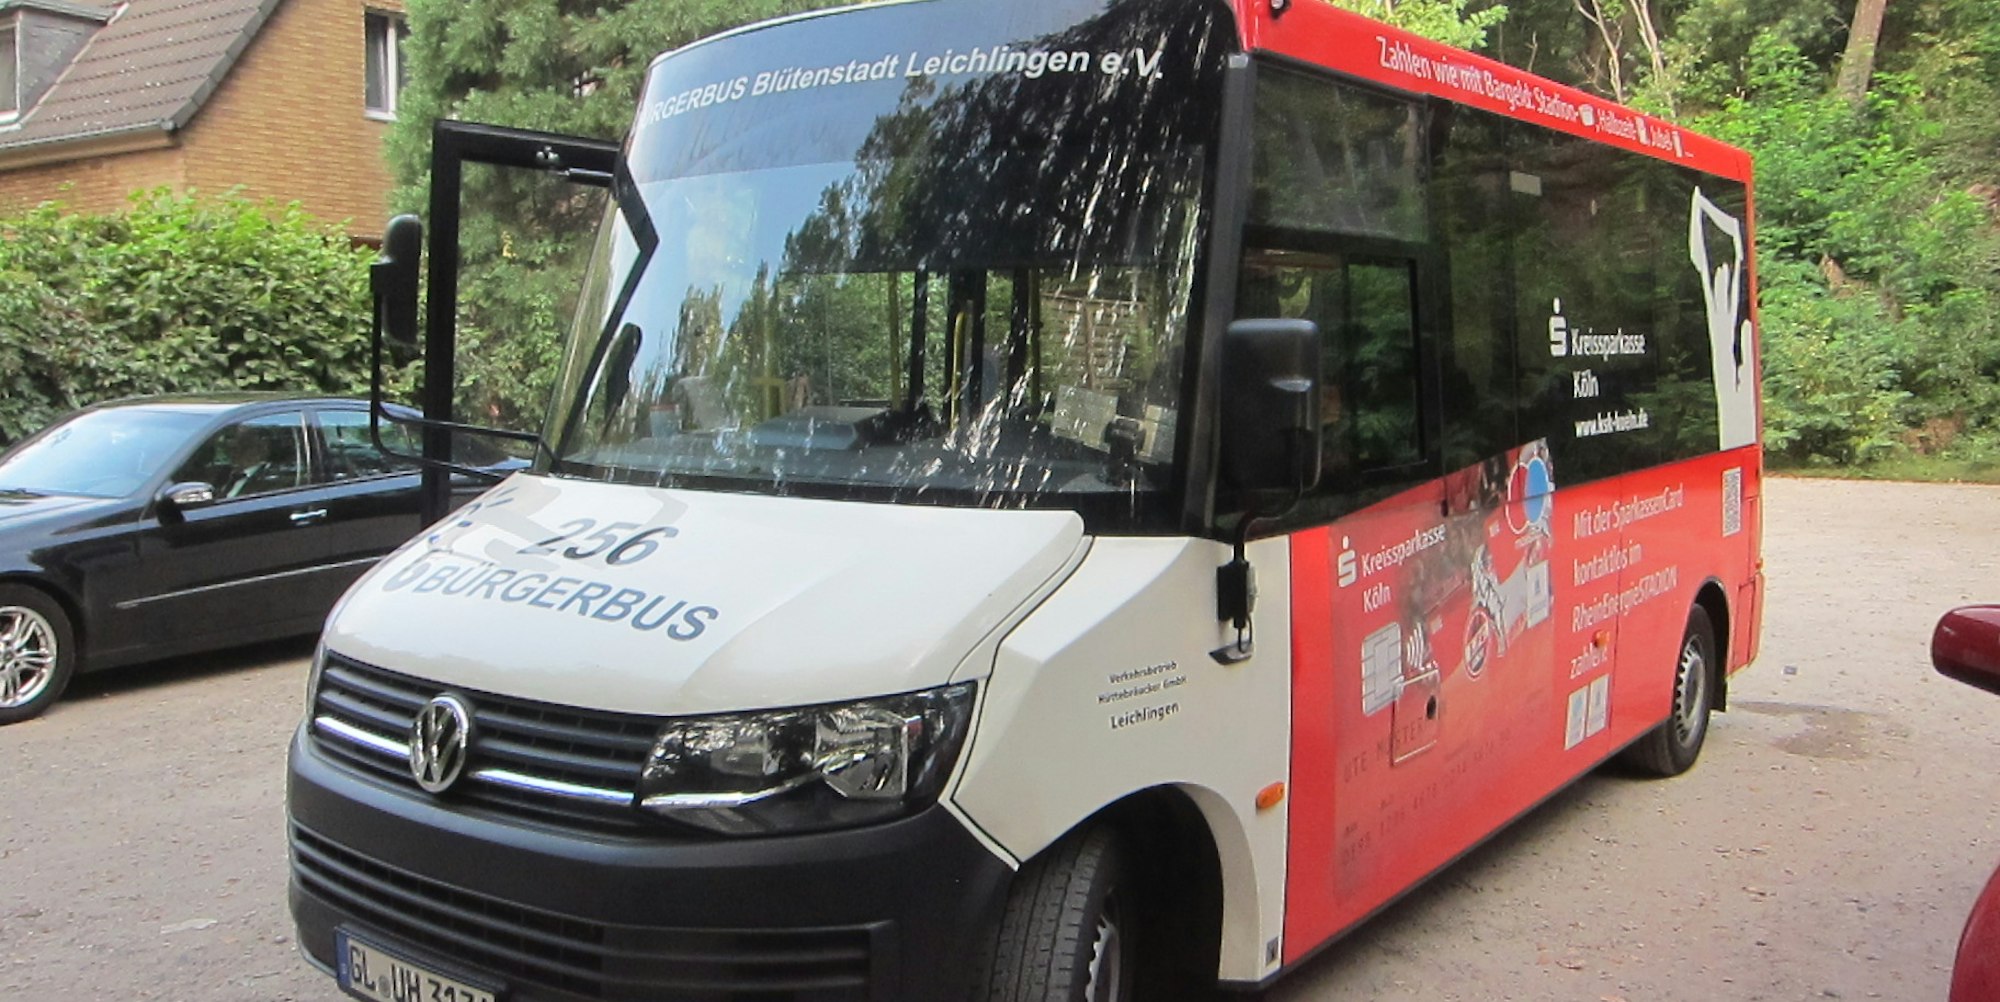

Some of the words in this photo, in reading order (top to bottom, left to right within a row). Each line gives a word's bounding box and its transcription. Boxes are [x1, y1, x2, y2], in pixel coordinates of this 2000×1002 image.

[752, 54, 899, 95] Blütenstadt
[904, 45, 1090, 79] Leichlingen
[1101, 48, 1164, 79] e.V.
[1376, 36, 1432, 80] Zahlen
[1432, 55, 1459, 88] wie
[1460, 65, 1484, 95] mit
[1570, 327, 1646, 362] Kreissparkasse
[1572, 368, 1600, 399] Köln
[516, 517, 680, 567] 256
[1574, 509, 1592, 540] Mit
[1593, 504, 1611, 533] der
[1361, 523, 1447, 577] Kreissparkasse
[1574, 545, 1627, 587] kontaktlos
[1629, 539, 1642, 566] im
[413, 560, 720, 642] BÜRGERBUS
[1362, 582, 1391, 613] Köln
[1110, 701, 1180, 730] Leichlingen
[350, 945, 377, 992] GL
[391, 962, 421, 1002] UH
